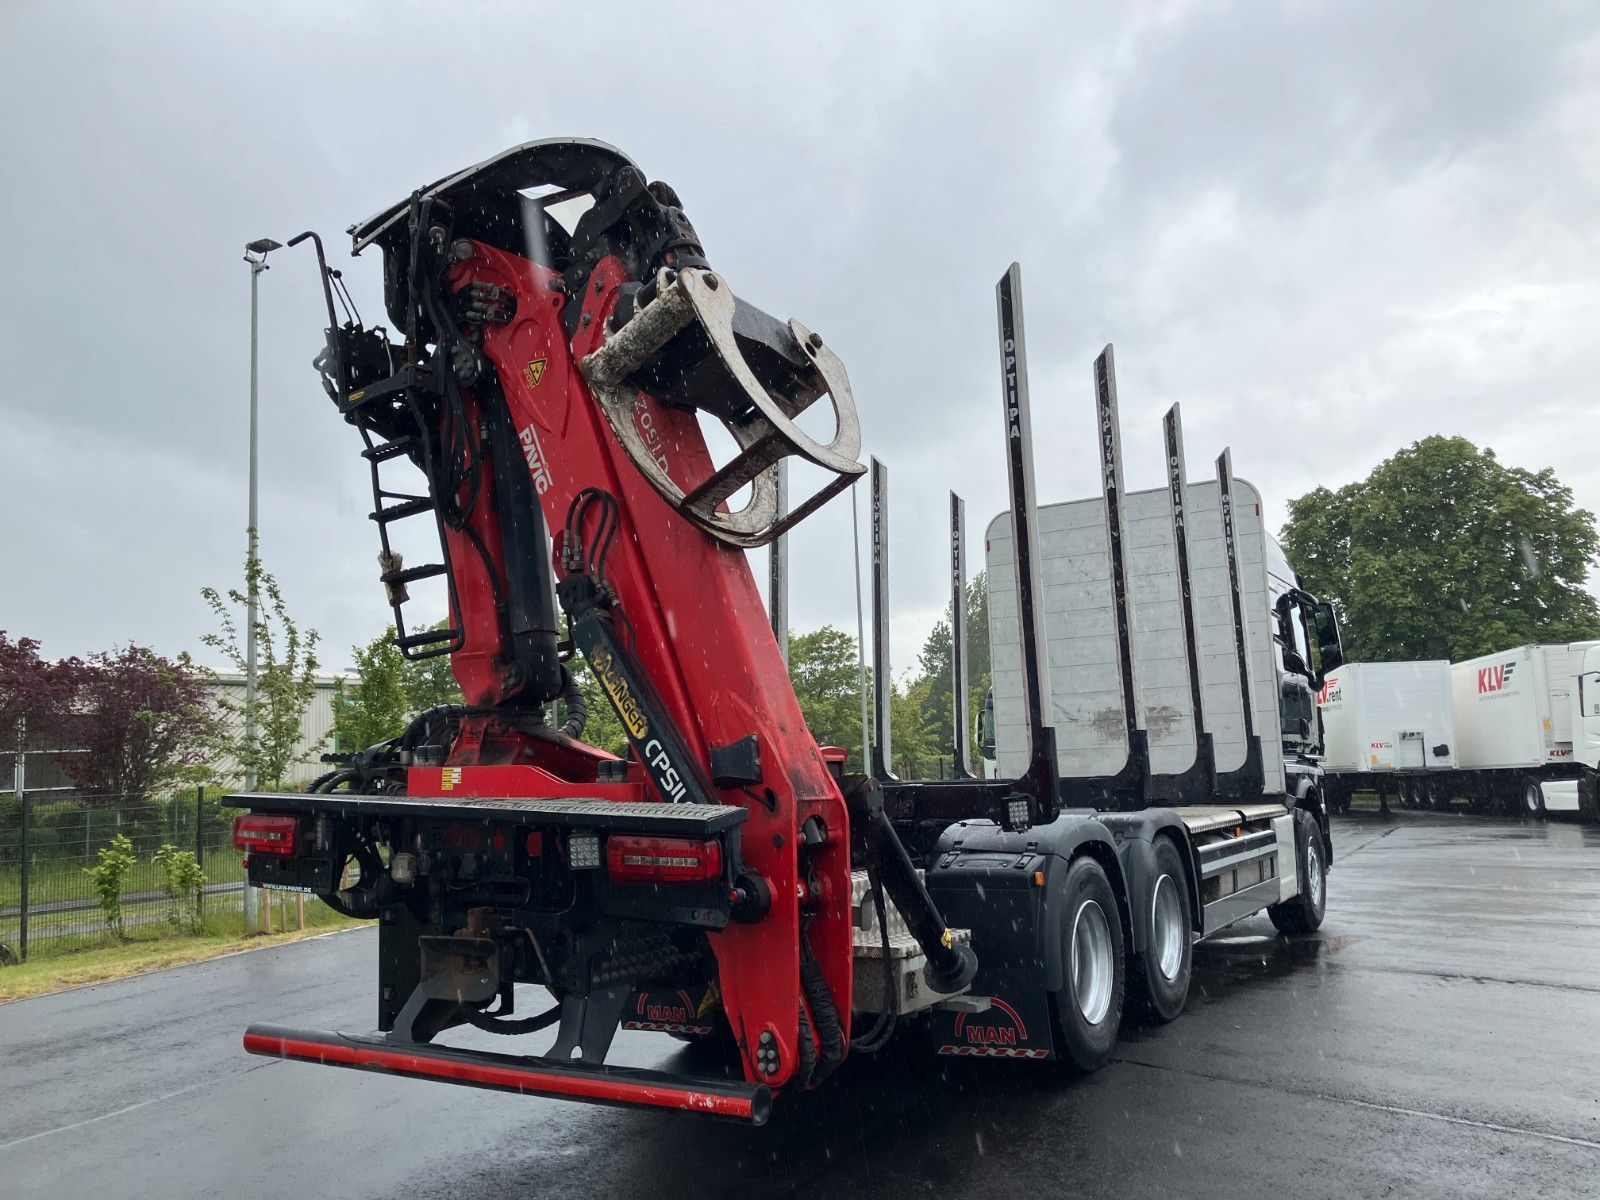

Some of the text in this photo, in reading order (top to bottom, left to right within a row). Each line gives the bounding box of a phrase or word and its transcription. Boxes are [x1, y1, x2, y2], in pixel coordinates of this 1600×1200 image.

[1004, 339, 1020, 439] OPTIPA
[518, 426, 549, 495] PAVIC
[1478, 664, 1504, 693] KLV
[647, 1004, 687, 1023] MAN
[966, 1025, 1016, 1045] MAN
